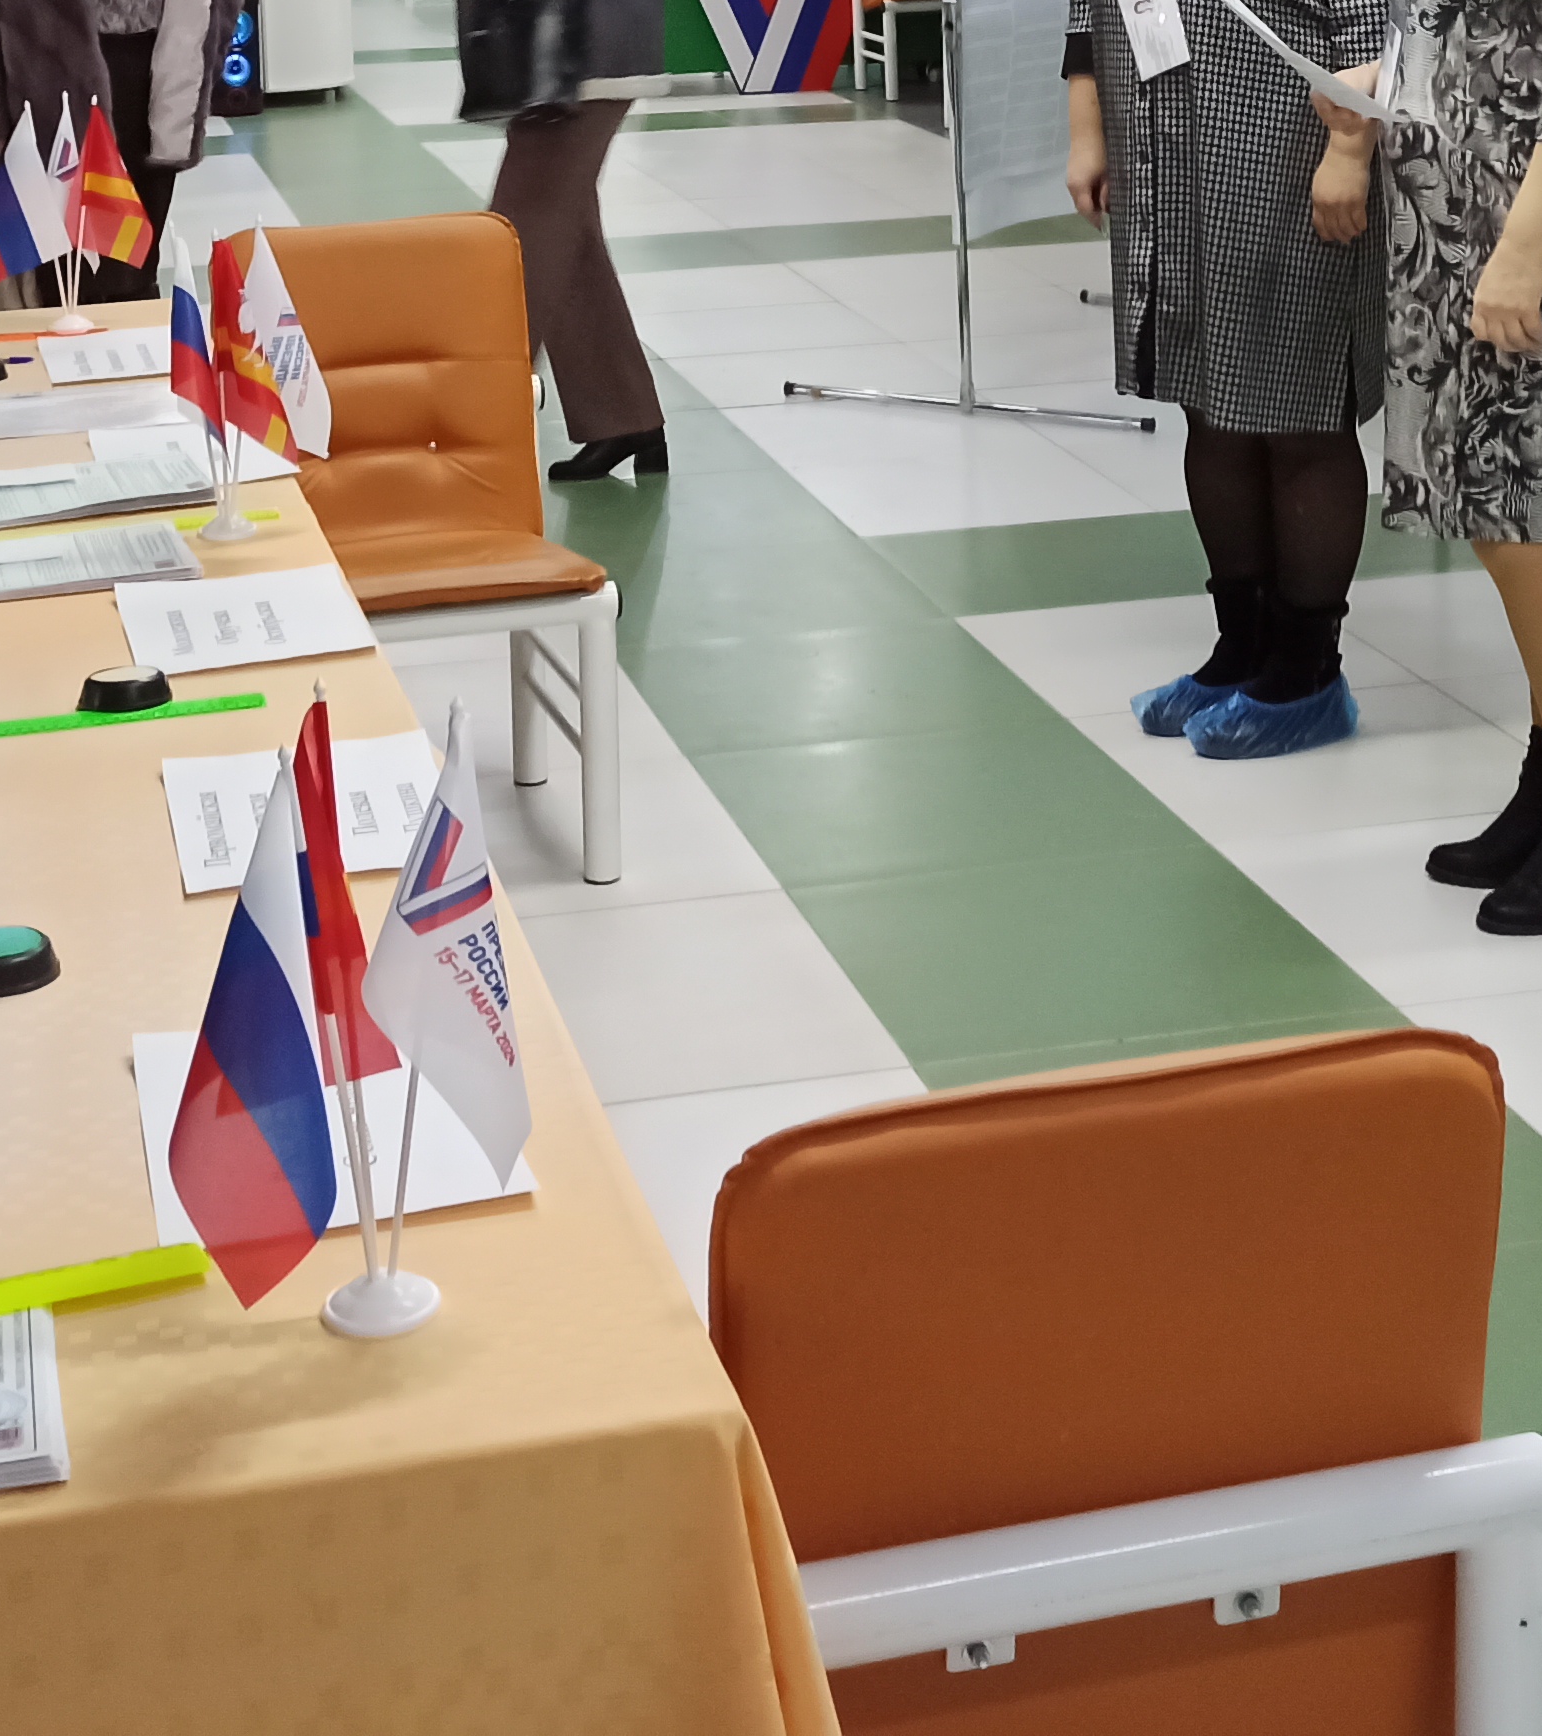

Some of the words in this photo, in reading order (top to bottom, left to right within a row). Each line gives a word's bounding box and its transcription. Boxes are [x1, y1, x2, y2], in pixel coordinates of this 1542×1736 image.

[196, 791, 237, 869] Первомайская
[348, 790, 380, 836] Полевая
[458, 933, 509, 1011] РОССИИ
[465, 984, 502, 1035] МАРТА
